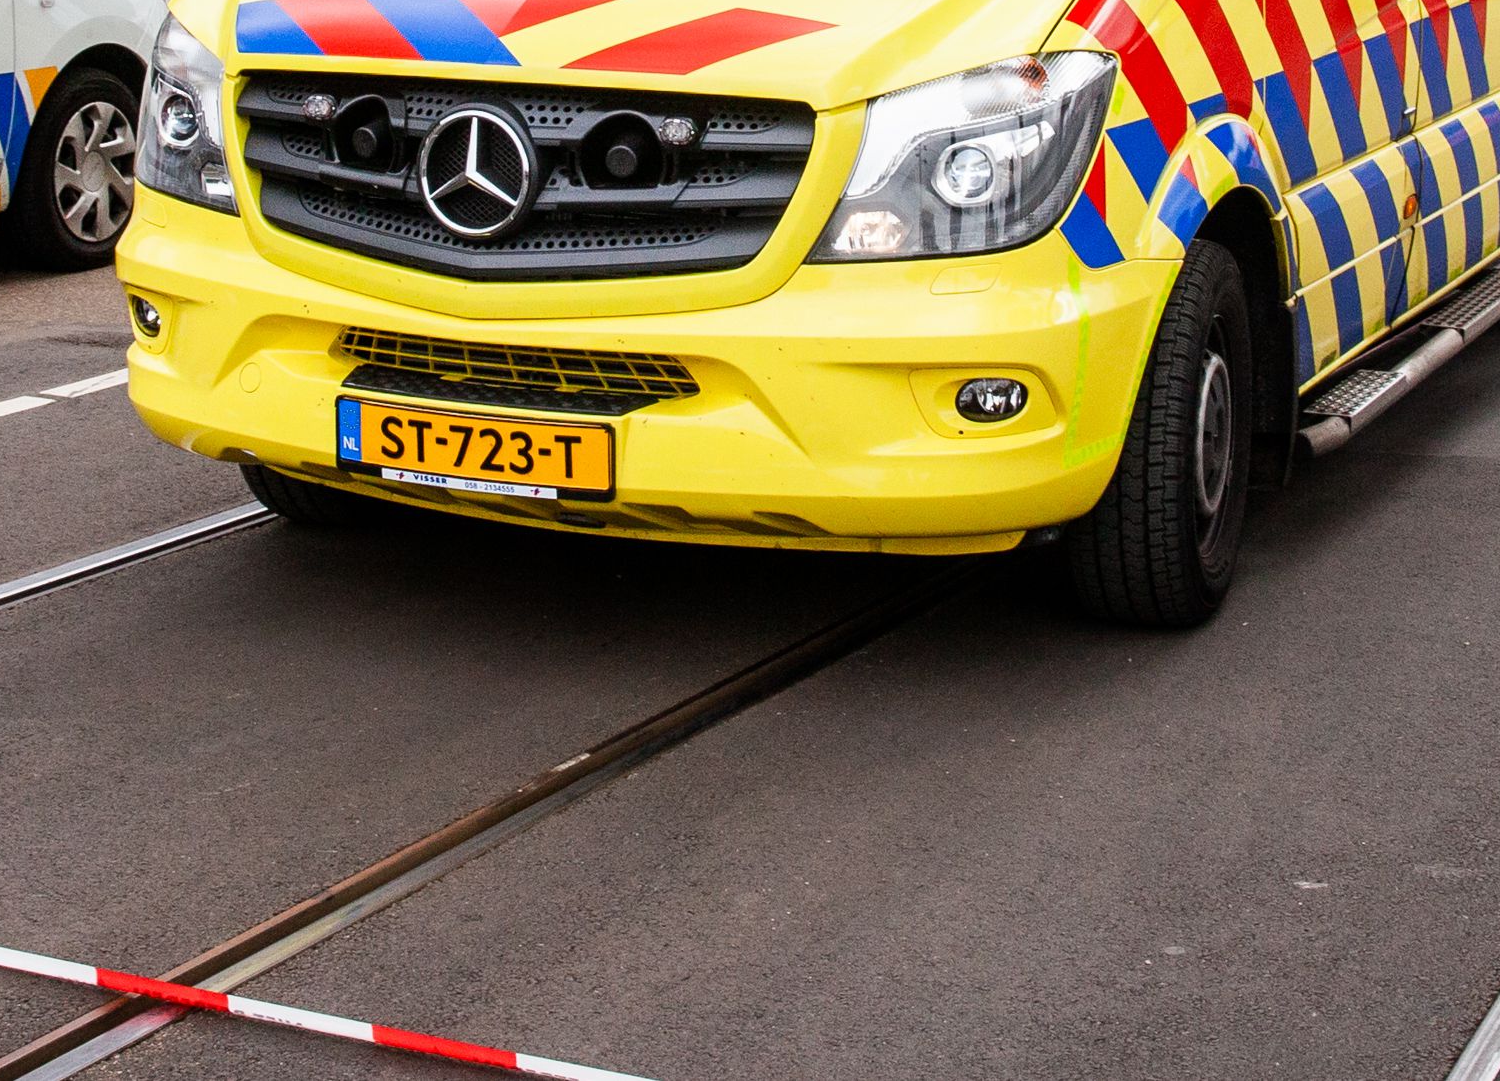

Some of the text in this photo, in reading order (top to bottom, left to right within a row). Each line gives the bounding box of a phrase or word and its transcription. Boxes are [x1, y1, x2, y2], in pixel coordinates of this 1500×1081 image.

[343, 435, 359, 452] NL
[380, 416, 582, 478] ST-723-T
[413, 474, 448, 485] VISSER
